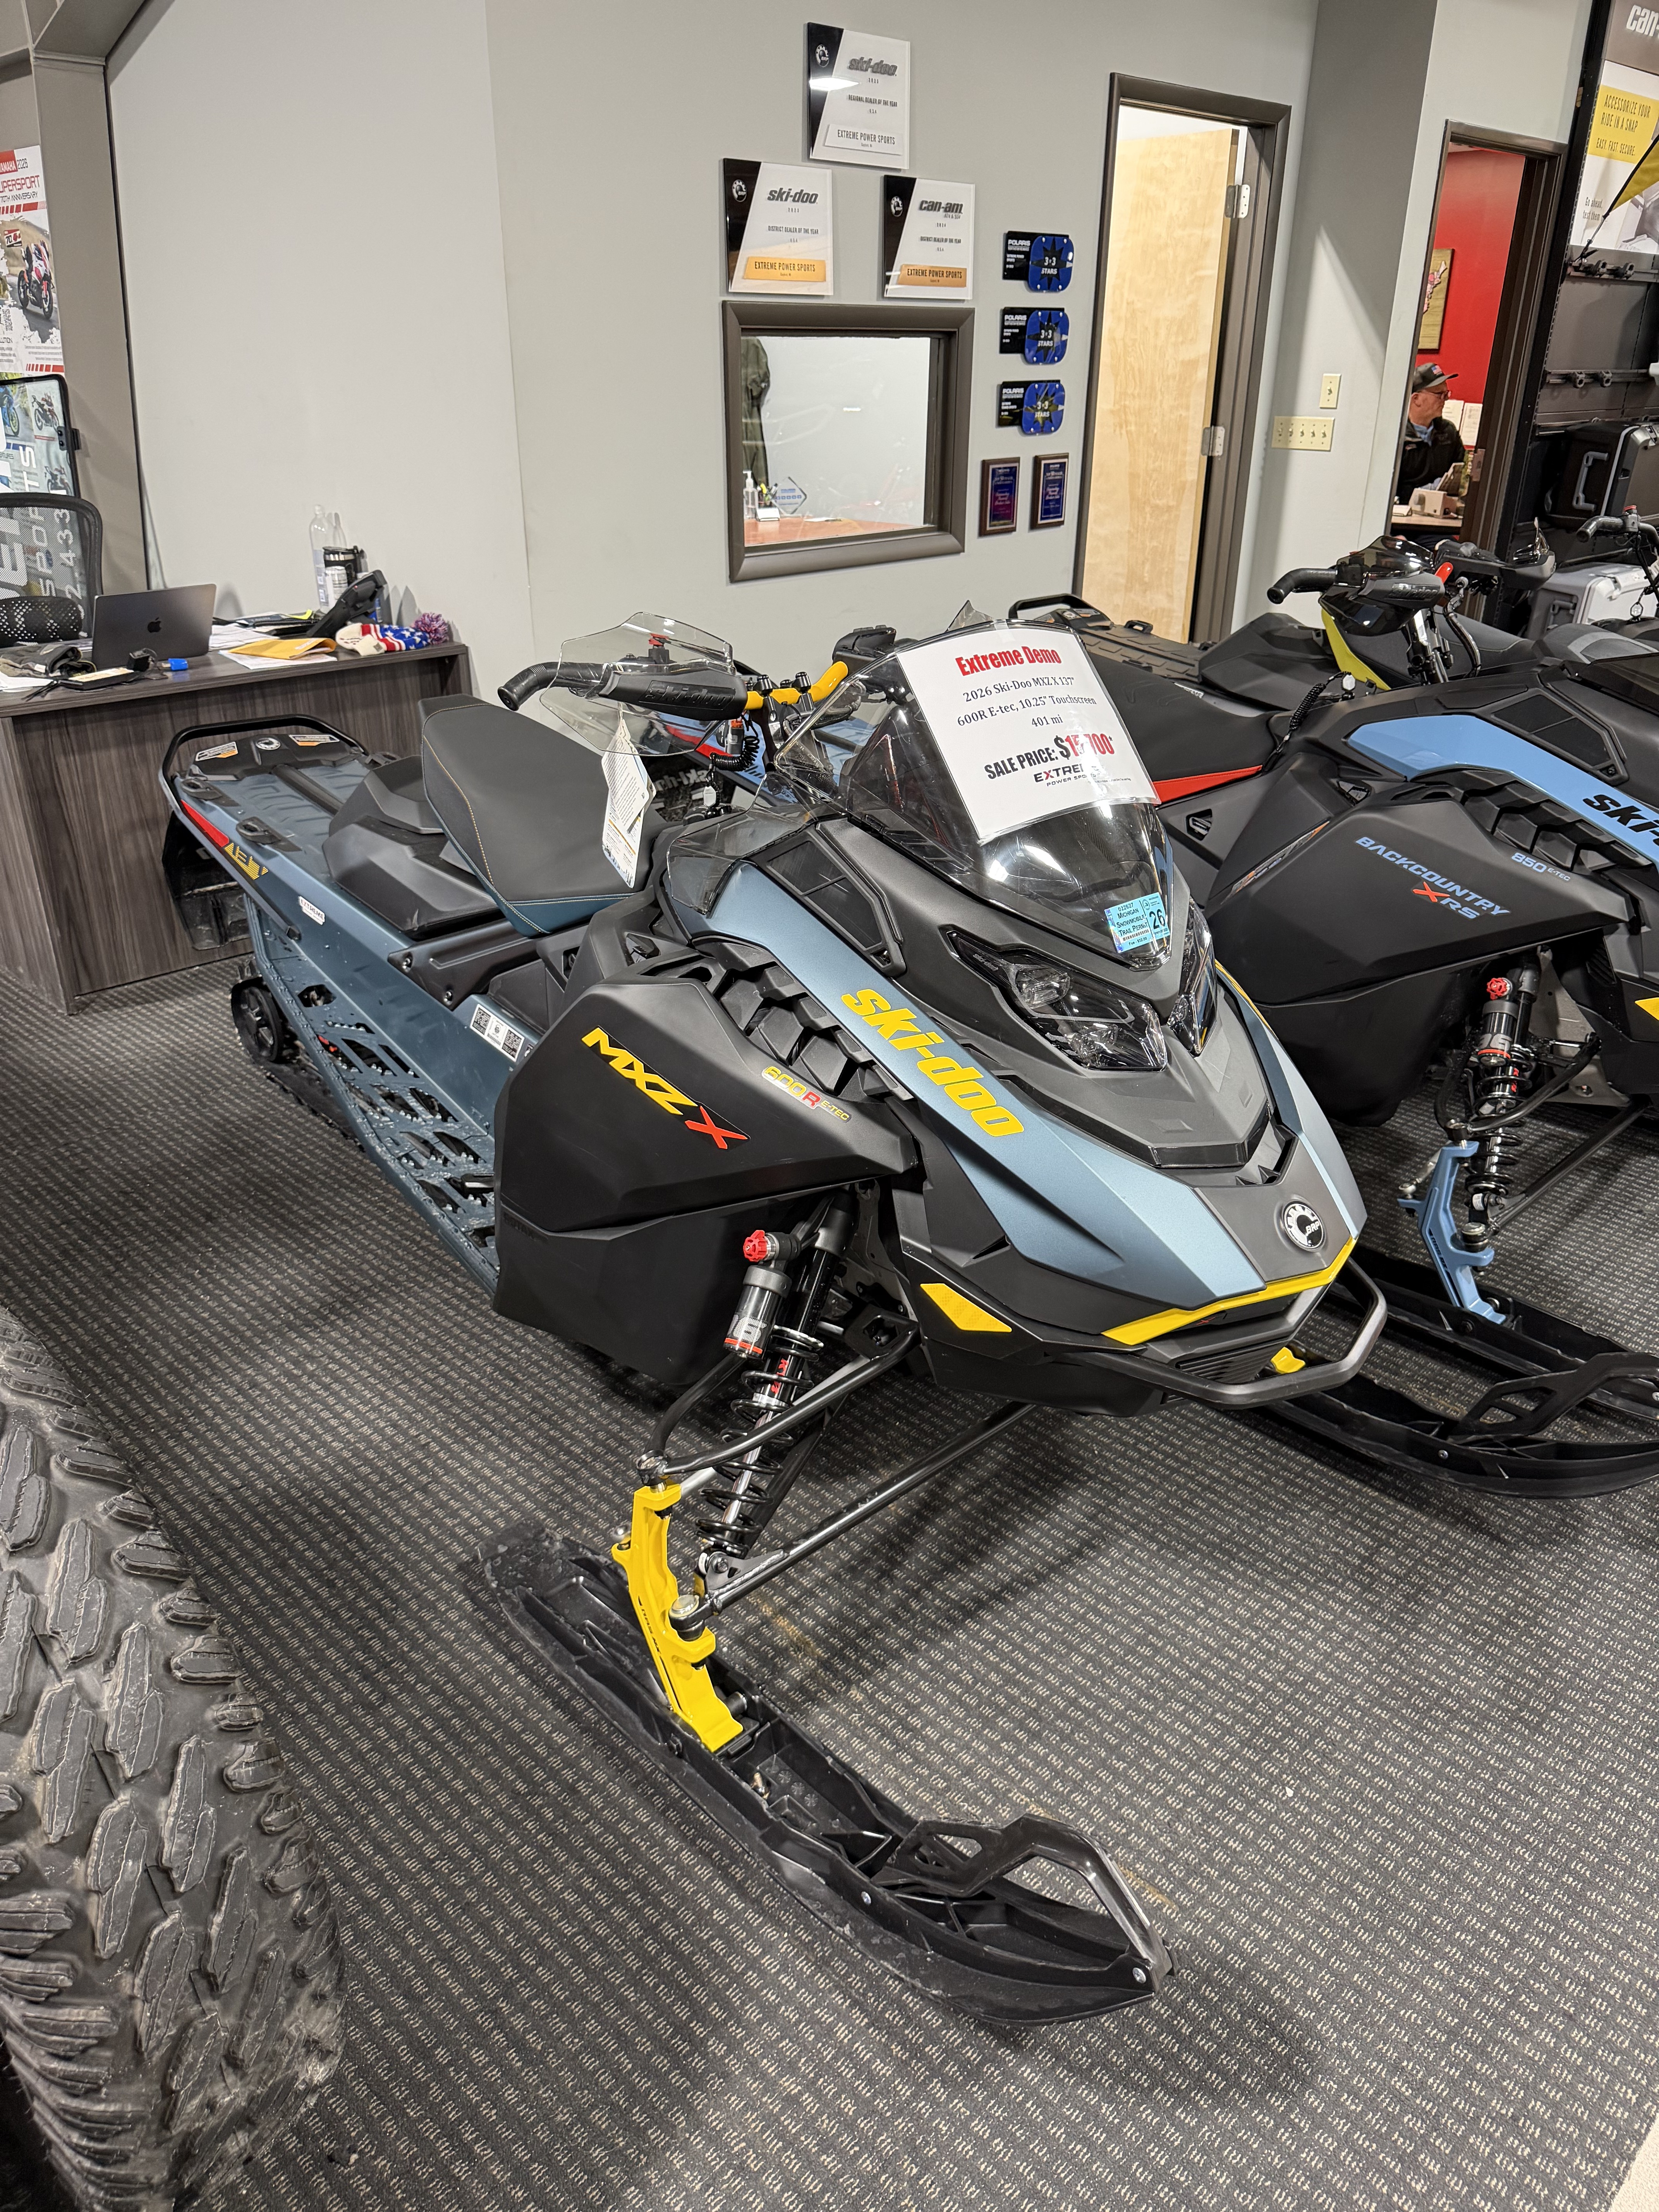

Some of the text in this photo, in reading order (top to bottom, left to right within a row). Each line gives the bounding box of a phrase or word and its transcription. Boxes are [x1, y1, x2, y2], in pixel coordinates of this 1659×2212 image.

[1626, 5, 1659, 38] can-
[848, 57, 897, 76] ski-doo
[1604, 94, 1651, 118] ACCESSORIZE YOUR
[1601, 112, 1638, 132] RIDE IN A SNAP
[838, 129, 895, 145] EXTREME POWER SPORTS
[1596, 137, 1636, 156] EASY. FAST. SECURE.
[0, 160, 16, 173] AMAHA
[17, 158, 28, 169] 2026
[0, 175, 40, 193] UPERSPORT
[11, 191, 38, 201] ANNIVERSARY
[767, 187, 819, 204] ski-doo
[919, 200, 963, 213] can-am
[755, 261, 816, 272] EXTREME POWER SPORTS
[907, 268, 927, 276] EXTREME
[929, 270, 945, 278] POWER
[955, 646, 1062, 676] Extreme Demo
[963, 677, 1075, 702] 2026 Ski-Doo MXZ X 137"
[957, 694, 1097, 726] 600R E-tec, 10.25" Touchscreen
[1032, 714, 1063, 727] 401 mi
[984, 757, 1018, 779] SALE
[1016, 747, 1059, 769] PRICE:
[1034, 763, 1099, 783] EXTRE
[1047, 777, 1072, 787] POWER
[1583, 794, 1659, 846] ski-
[1511, 852, 1571, 881] 850 E-TEC
[1356, 837, 1510, 916] BACKCOUNTRY
[301, 899, 324, 921] EXTREME
[1118, 902, 1133, 911] 022627
[1118, 908, 1139, 919] MICHIGAN
[1116, 914, 1145, 928] SNOWMOBILE
[1149, 908, 1166, 929] 26
[1119, 927, 1132, 936] TRAIL
[841, 989, 1024, 1137] ski-doo
[581, 1027, 698, 1115] MXZ
[685, 1106, 749, 1149] X
[764, 1066, 850, 1120] 600R E-TEC
[1305, 1221, 1320, 1234] BRP
